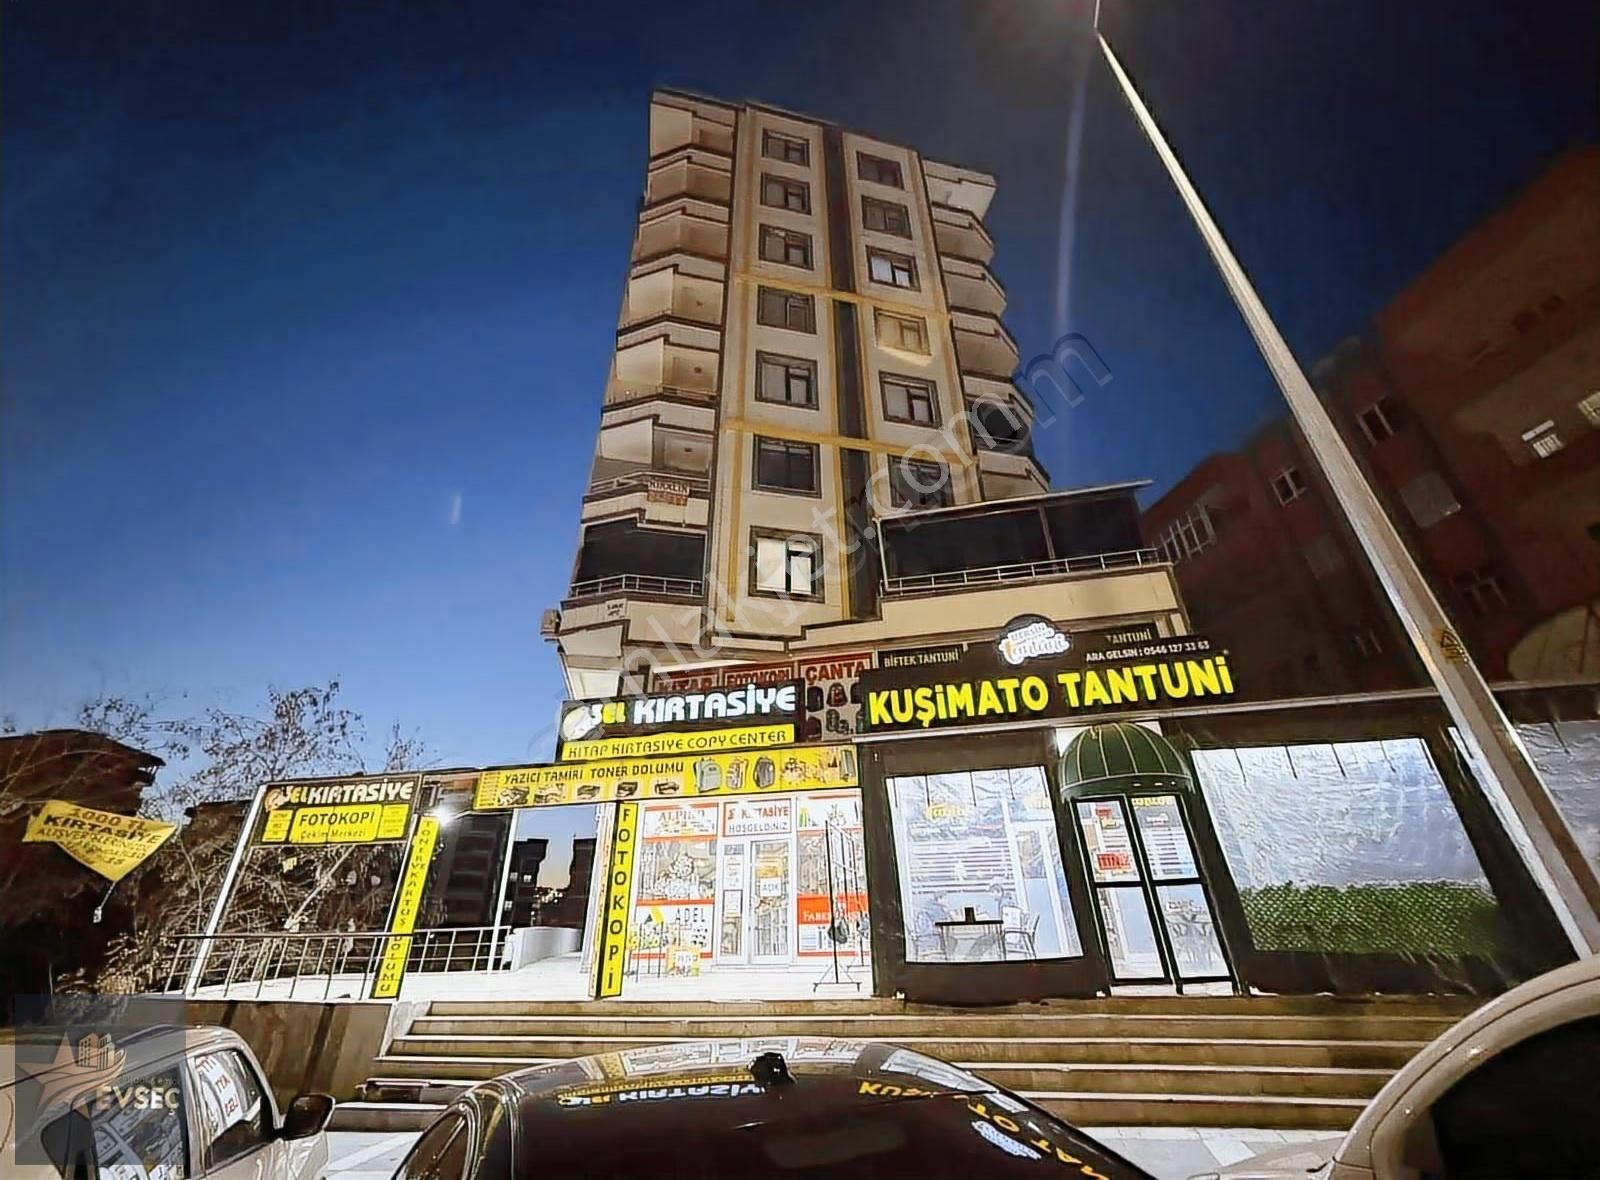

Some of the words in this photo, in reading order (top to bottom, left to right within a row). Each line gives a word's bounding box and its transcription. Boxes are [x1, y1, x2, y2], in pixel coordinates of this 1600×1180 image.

[884, 653, 917, 668] BİFTEK
[917, 648, 959, 664] TANTUNİ
[1086, 653, 1105, 662] ARA
[805, 660, 866, 685] ÇANTA
[633, 682, 796, 725] KIRTASİYE
[687, 735, 726, 749] COPY
[730, 729, 787, 745] CENTER
[591, 765, 628, 778] TONER
[632, 762, 684, 774] DOLUMU
[307, 779, 414, 804] KIRTASİYE
[299, 811, 376, 826] FOTOKOPİ
[607, 808, 631, 990] FOTOKOPİ
[675, 908, 706, 923] ADEL
